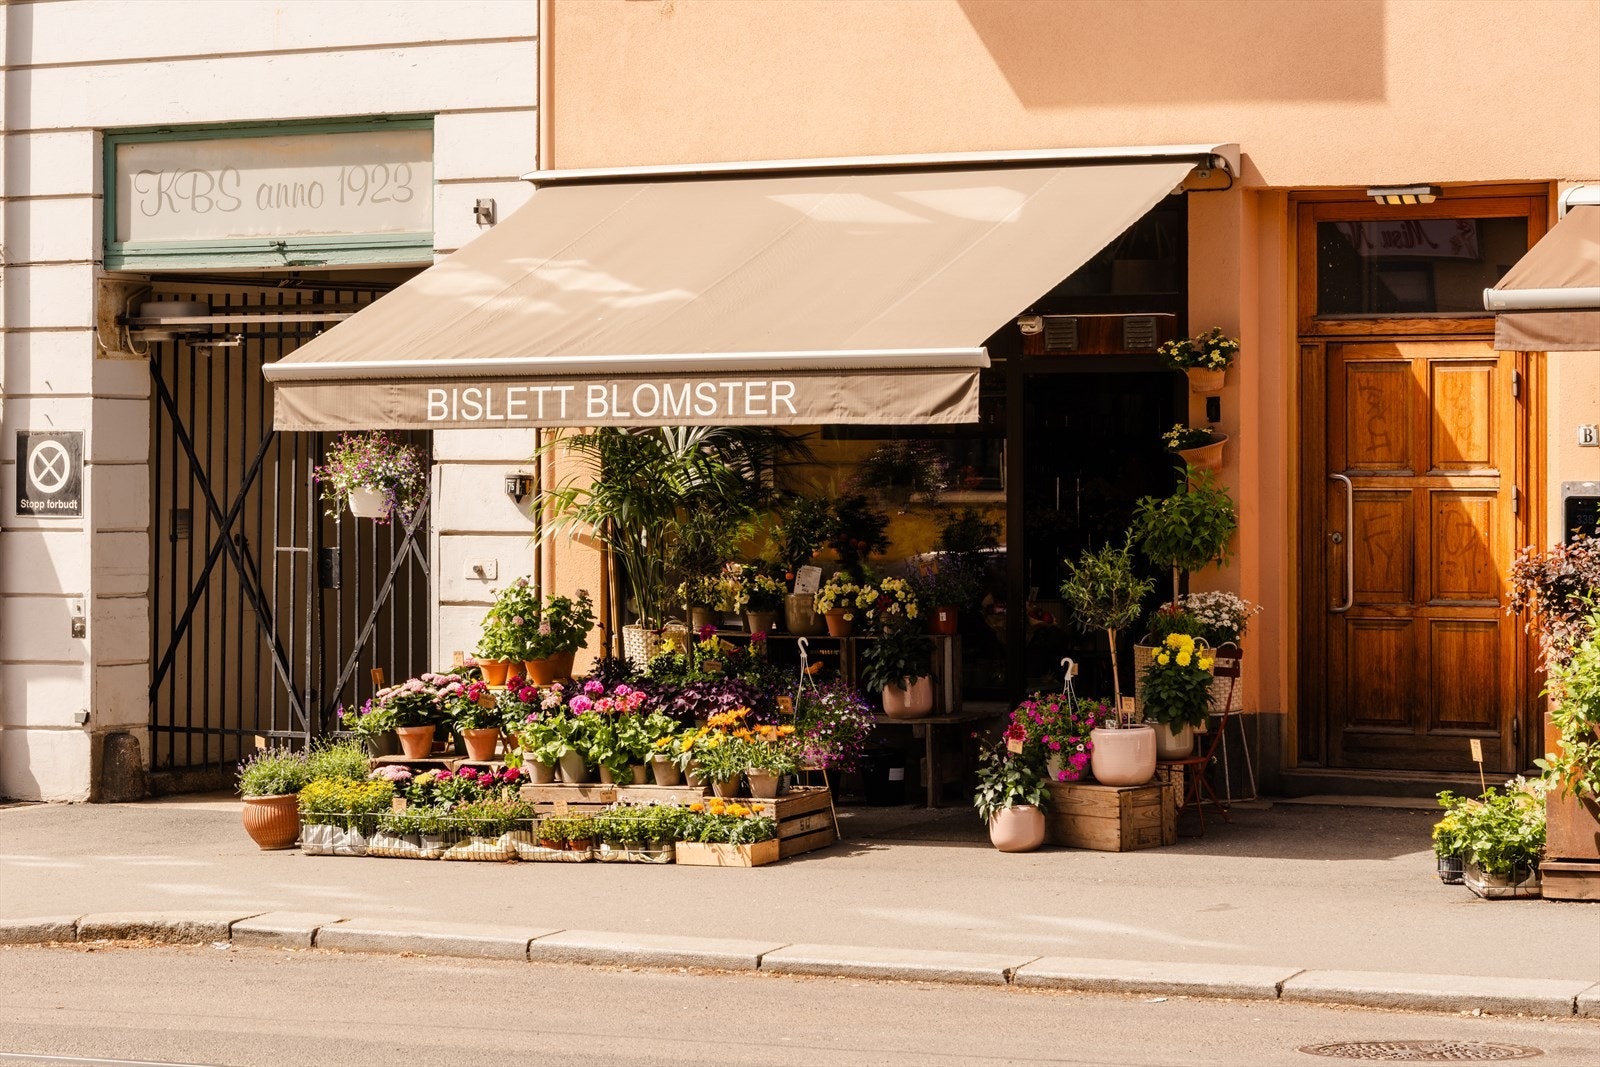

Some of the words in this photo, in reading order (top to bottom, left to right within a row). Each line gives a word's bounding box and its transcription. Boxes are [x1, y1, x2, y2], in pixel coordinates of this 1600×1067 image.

[134, 167, 242, 217] KBS
[256, 179, 324, 211] anno
[336, 162, 414, 207] 1923
[426, 385, 575, 421] BISLETT
[586, 381, 798, 418] BLOMSTER
[1583, 428, 1594, 443] B
[20, 498, 45, 510] Stopp
[47, 499, 78, 509] forbudt
